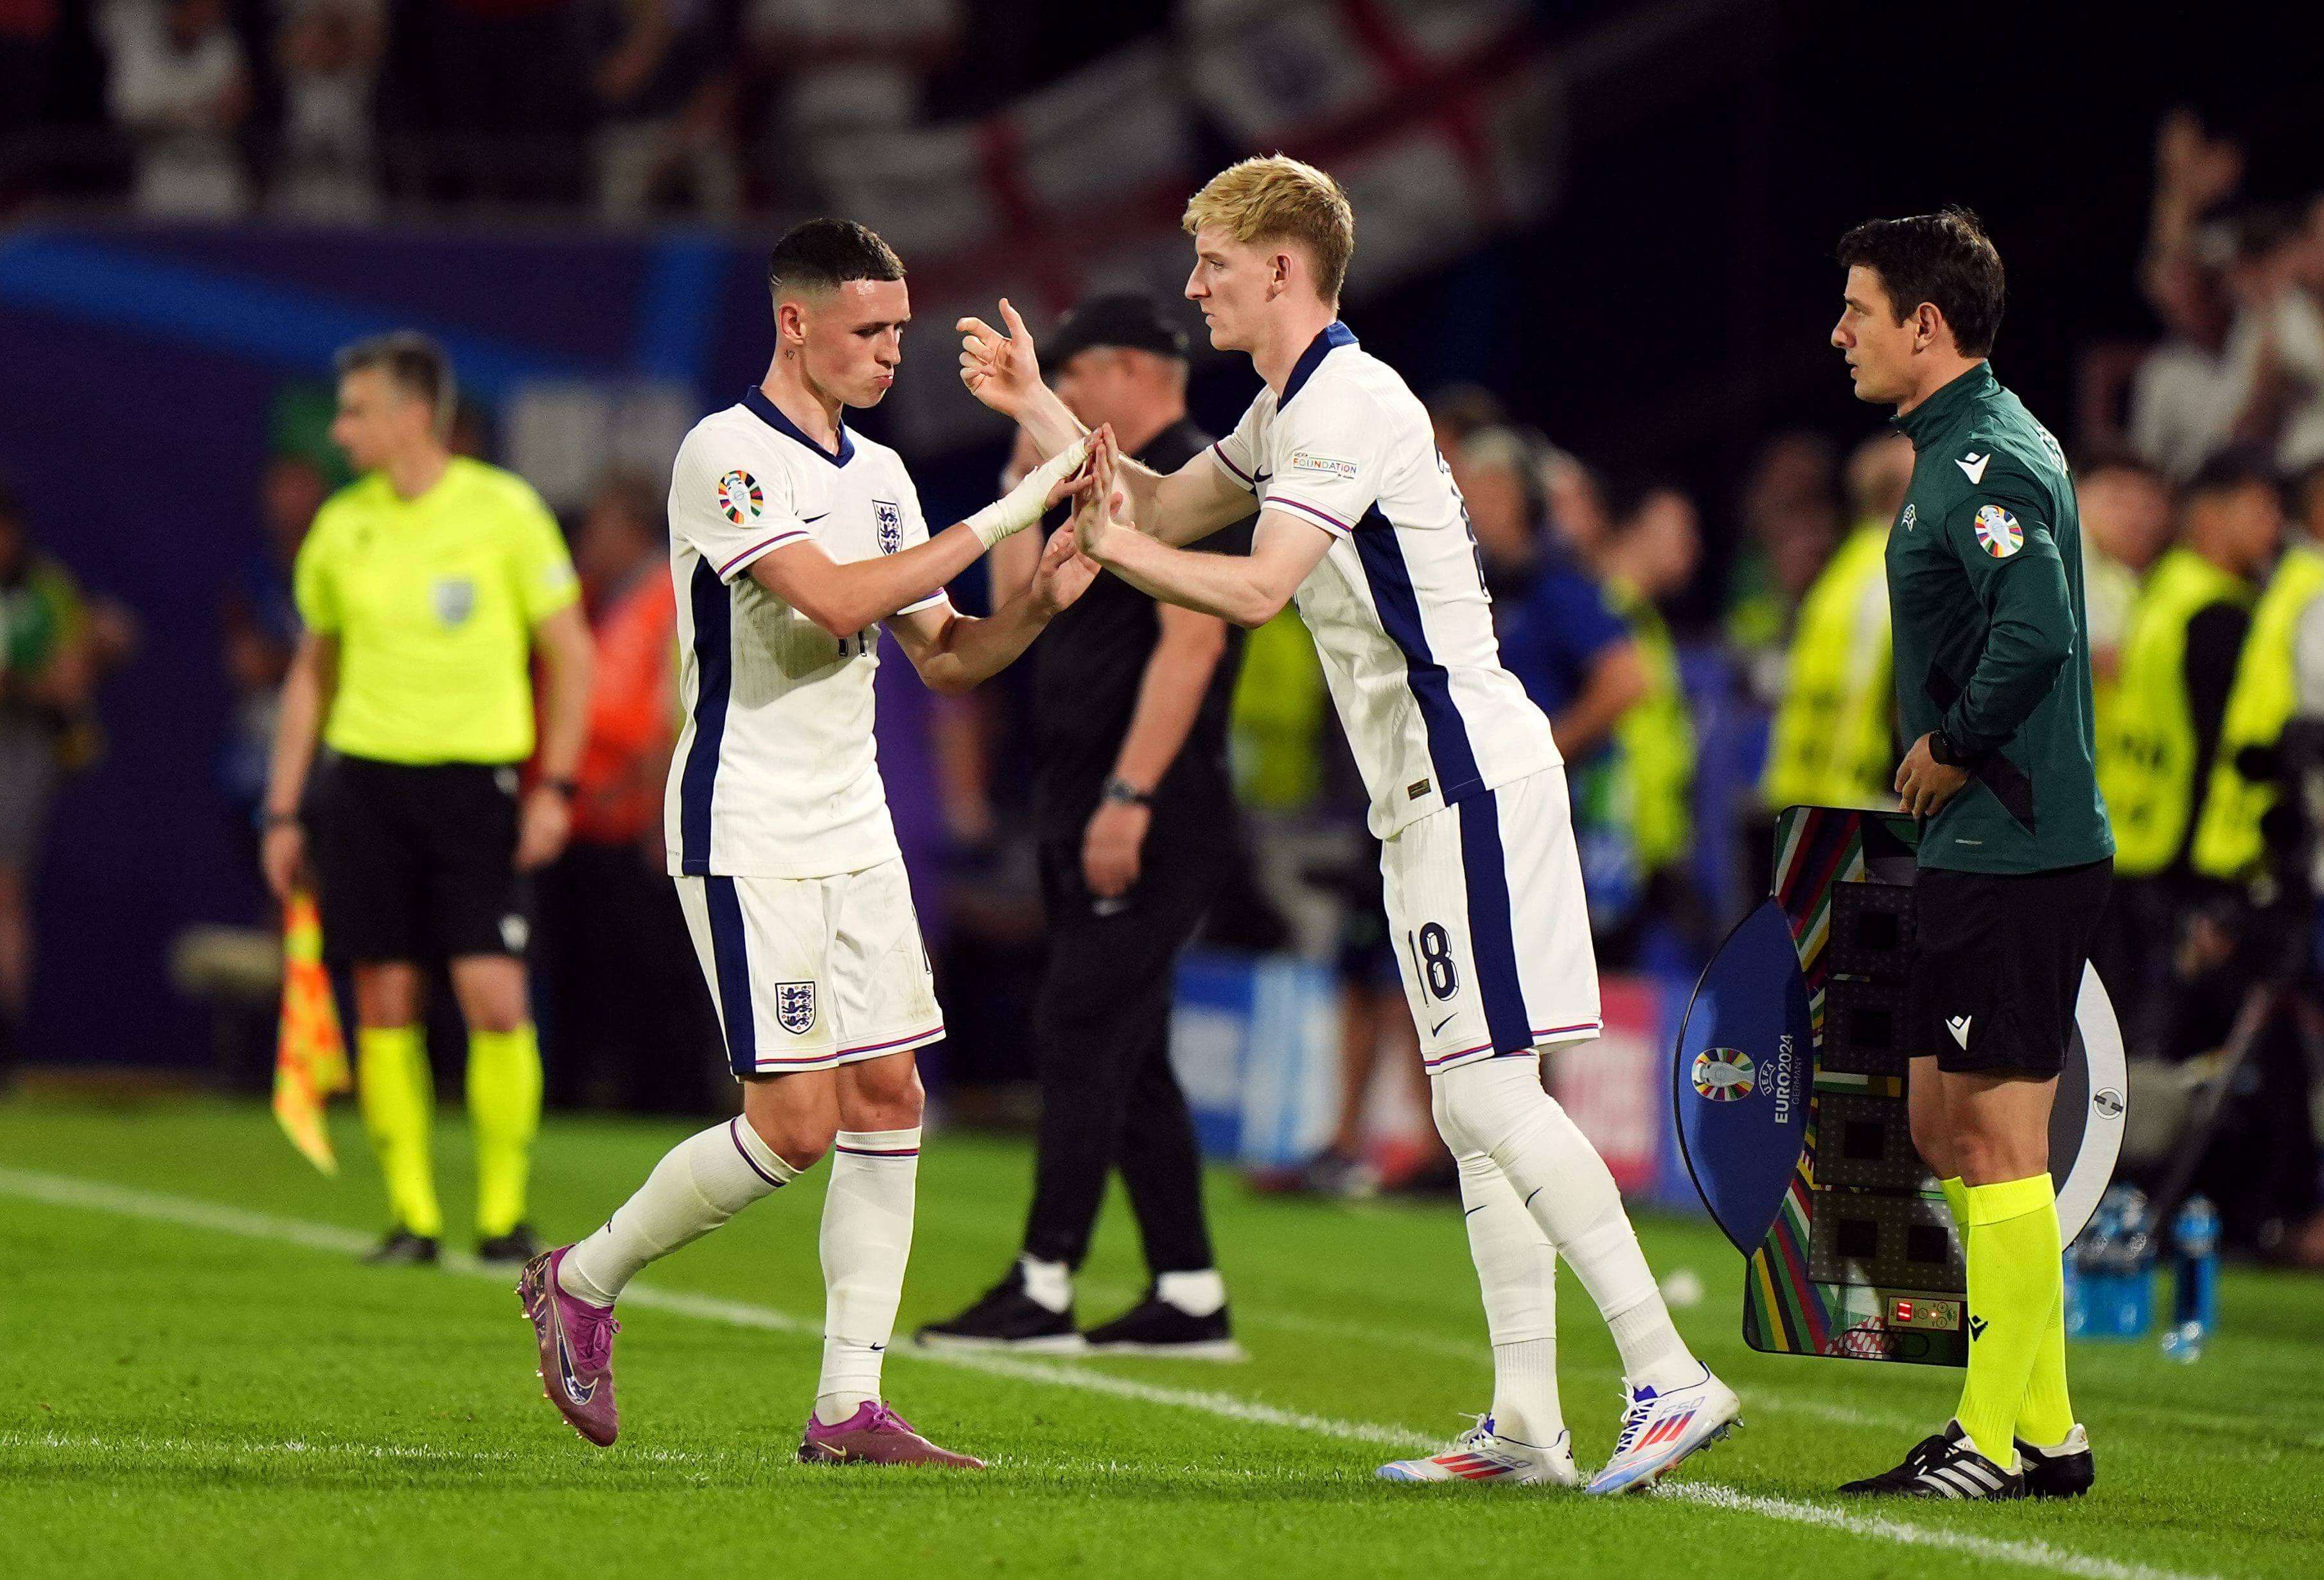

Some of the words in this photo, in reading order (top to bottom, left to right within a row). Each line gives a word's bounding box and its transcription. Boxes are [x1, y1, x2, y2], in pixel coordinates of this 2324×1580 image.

[1293, 457, 1357, 474] FOUNDATION
[1408, 921, 1460, 1008] 18
[1761, 1063, 1775, 1095] UEFA
[1775, 1033, 1793, 1124] EURO2024
